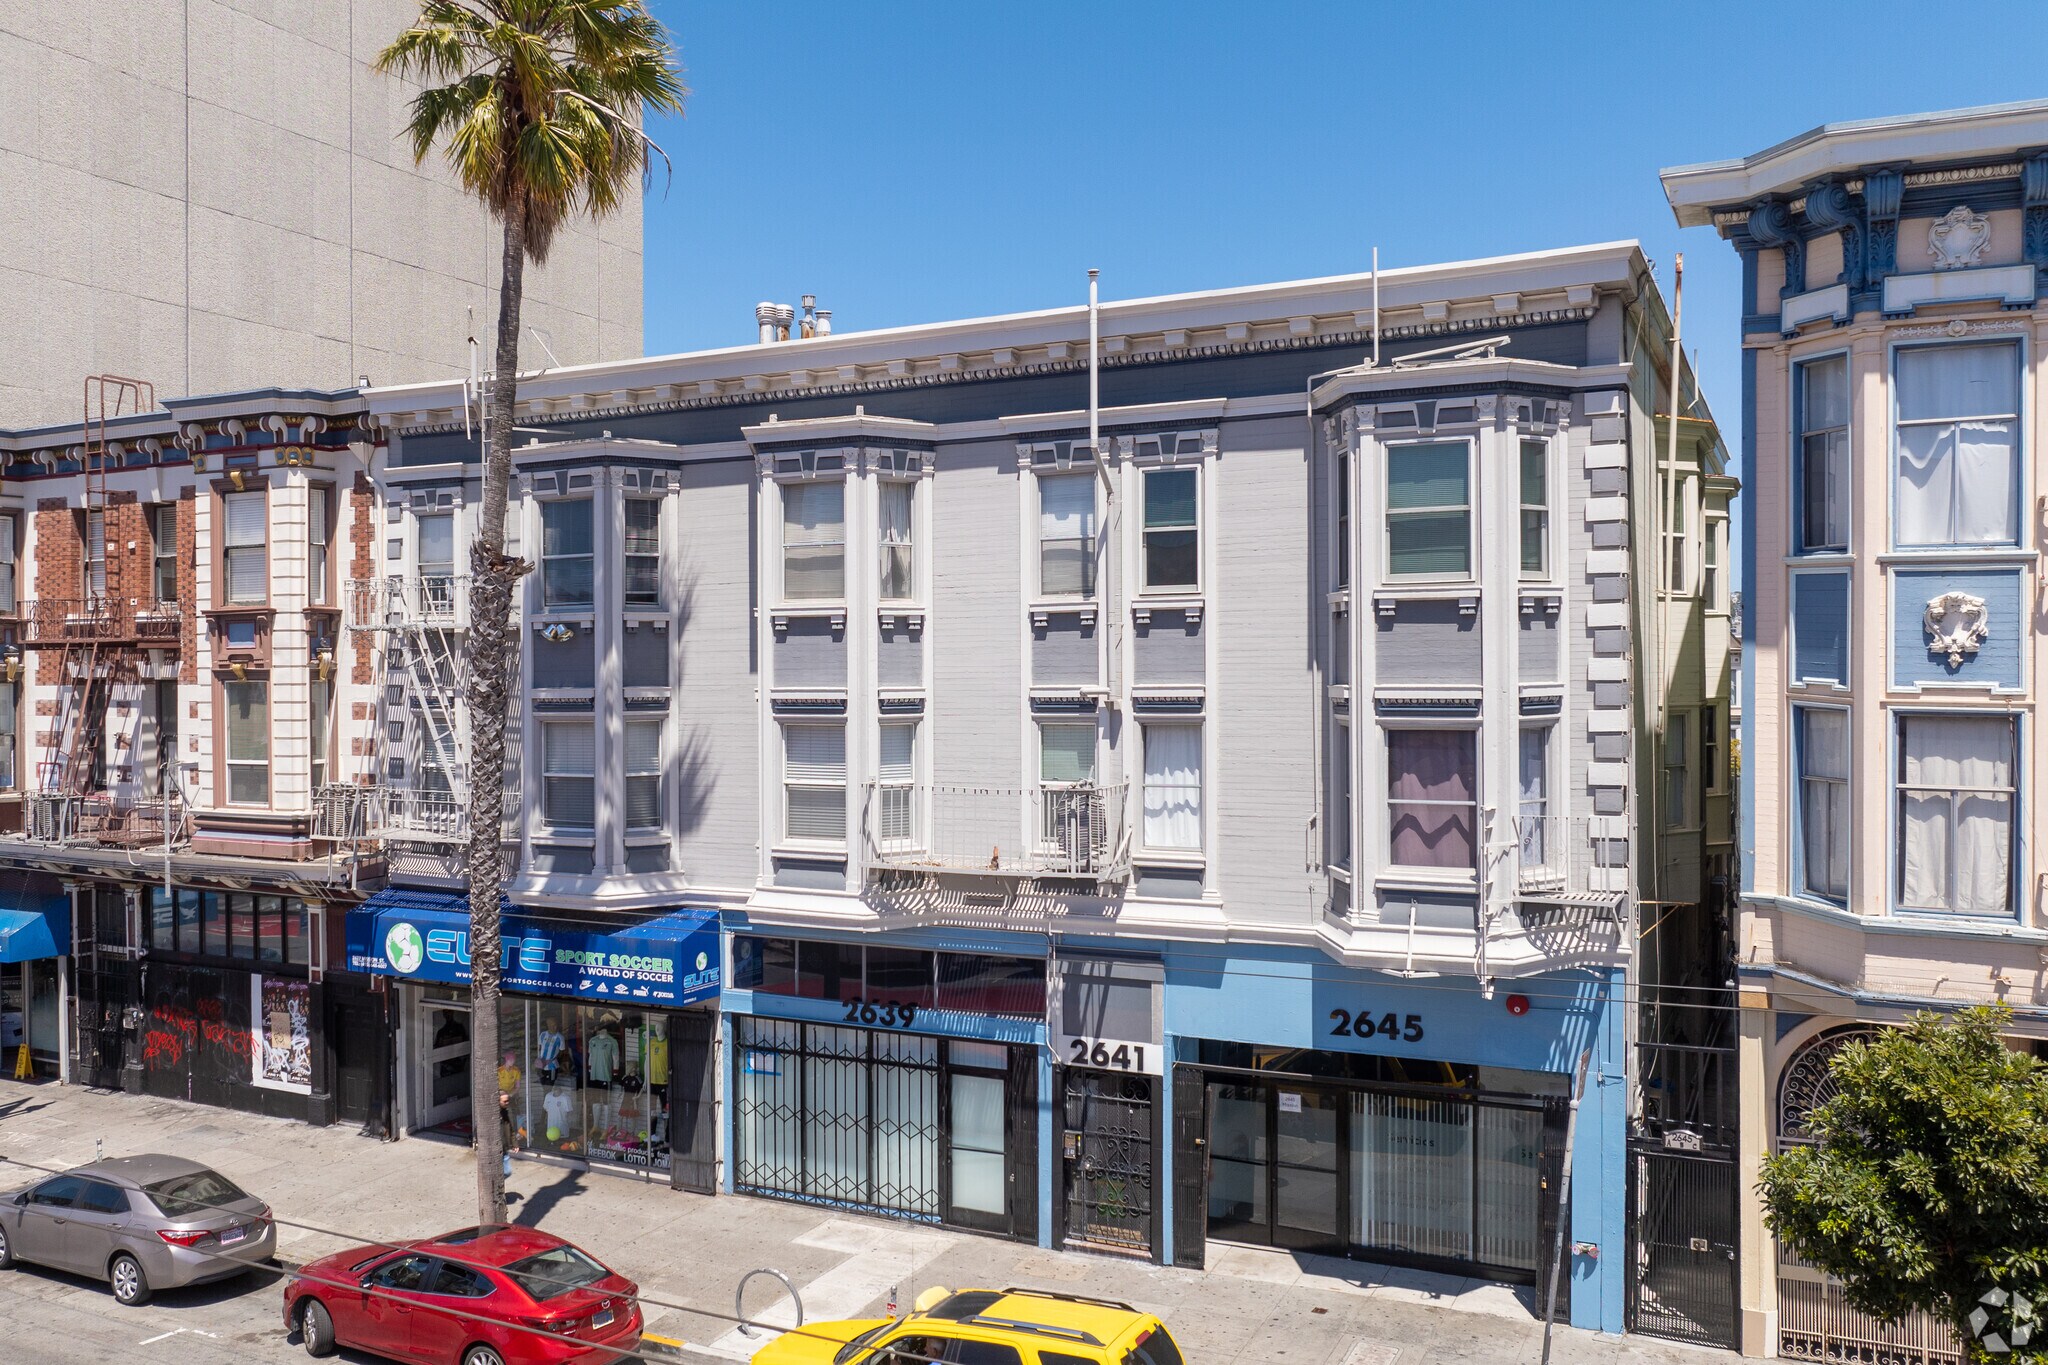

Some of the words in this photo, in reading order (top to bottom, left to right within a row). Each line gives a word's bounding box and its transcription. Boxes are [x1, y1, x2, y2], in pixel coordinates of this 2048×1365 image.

[426, 929, 552, 973] ELTE
[555, 949, 605, 966] SPORT
[609, 954, 674, 972] SOCCER
[587, 967, 620, 977] WORLD
[622, 971, 635, 979] OF
[637, 972, 674, 983] SOCCER
[684, 967, 719, 988] ELITE
[842, 999, 917, 1027] 2639
[1329, 1008, 1424, 1043] 2645
[1070, 1038, 1144, 1072] 2641
[1672, 1133, 1693, 1143] 2645
[588, 1147, 616, 1160] REEBOK
[623, 1153, 647, 1165] LOTTO
